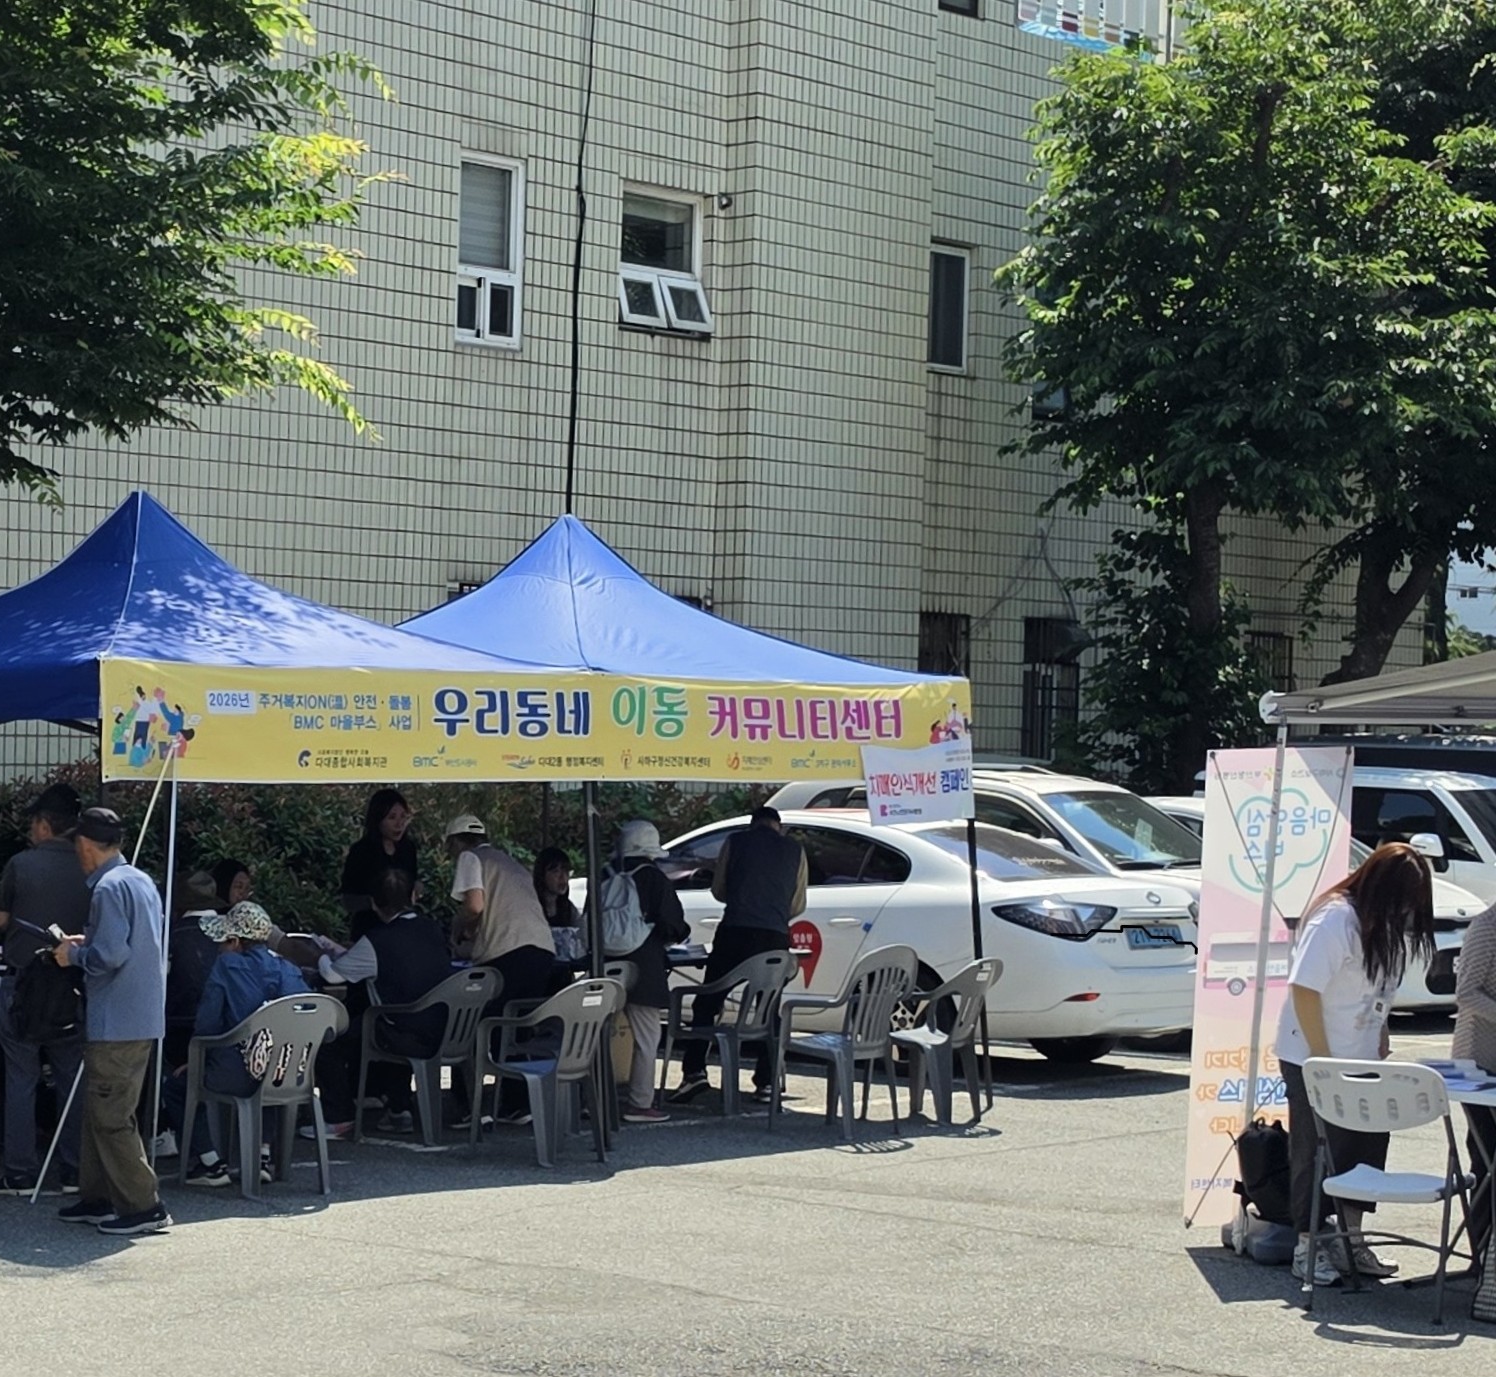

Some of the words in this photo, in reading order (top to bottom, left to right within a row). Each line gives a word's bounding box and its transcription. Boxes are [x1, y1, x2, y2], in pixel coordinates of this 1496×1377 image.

[208, 692, 251, 709] 2026년
[353, 694, 378, 710] 안전
[388, 695, 412, 710] 돌봄
[388, 714, 412, 731] 사업
[433, 687, 591, 738] 우리동네
[611, 686, 688, 739] 이동
[707, 695, 903, 742] 커뮤니티센터
[315, 756, 388, 768] 다대종합사회복지관
[413, 756, 439, 768] BMC
[869, 771, 936, 797] 치매인식개선
[939, 768, 969, 793] 캠페인
